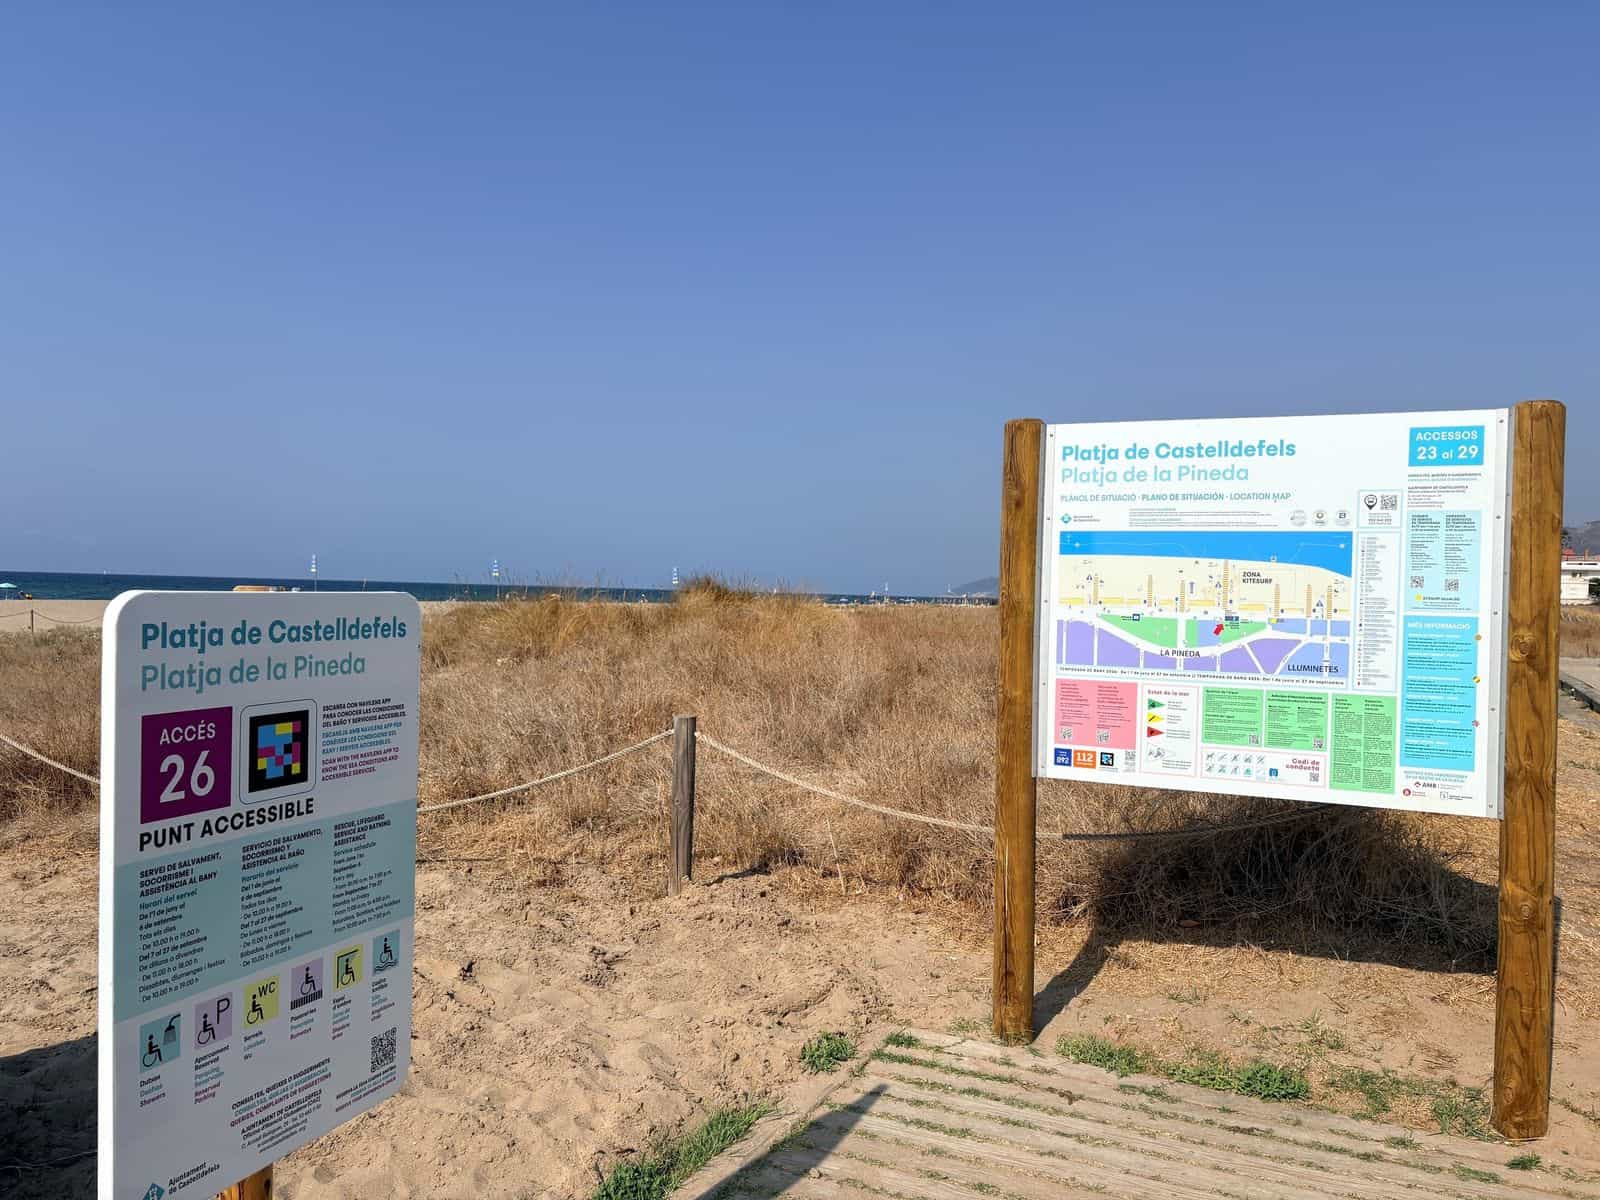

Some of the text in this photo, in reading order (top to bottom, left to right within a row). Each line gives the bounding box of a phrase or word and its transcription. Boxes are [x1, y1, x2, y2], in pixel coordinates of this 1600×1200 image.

[1416, 431, 1478, 441] ACCESSOS
[1062, 440, 1296, 464] Platja de Castelldefels
[1416, 445, 1479, 460] 23 al 29
[1061, 464, 1249, 486] Platja de la Pineda
[1102, 493, 1136, 502] SITUACIÓ
[1180, 492, 1224, 500] SITUACIÓN
[142, 616, 406, 654] Platja de Castelldefels
[1172, 650, 1200, 658] PINEDA
[142, 652, 366, 694] Platja de la Pineda
[1288, 664, 1338, 673] LLUMINETES
[337, 709, 362, 718] CONOCER
[160, 720, 216, 745] ACCÉS
[1076, 752, 1094, 762] 112
[160, 751, 215, 803] 26
[1286, 763, 1320, 772] conducta
[139, 798, 314, 851] PUNT ACCESSIBLE
[334, 828, 356, 839] SERVICE
[242, 840, 272, 853] SERVICIO
[242, 845, 285, 862] SOCORRISMO
[140, 852, 221, 878] SERVEI DE SALVAMENT,
[242, 856, 278, 870] ASISTENCIA
[288, 849, 304, 859] BAÑO
[140, 869, 189, 888] SOCORRISME
[140, 872, 216, 897] ASSISTÈNCIA AL BANY
[139, 888, 197, 910] Horari del servei
[165, 905, 178, 915] juny
[154, 914, 182, 926] setembre
[163, 926, 176, 934] dies
[139, 952, 150, 962] Del
[155, 949, 162, 957] al
[180, 936, 207, 949] setembre
[258, 982, 276, 998] WC
[216, 998, 230, 1024] P
[140, 1093, 166, 1107] Showers
[241, 1112, 276, 1134] AJUNTAMENT
[276, 1108, 284, 1116] DE
[284, 1089, 322, 1112] CASTELLDEFELS
[168, 1164, 220, 1195] de Castelldefels
[169, 1162, 206, 1186] Ajuntament
